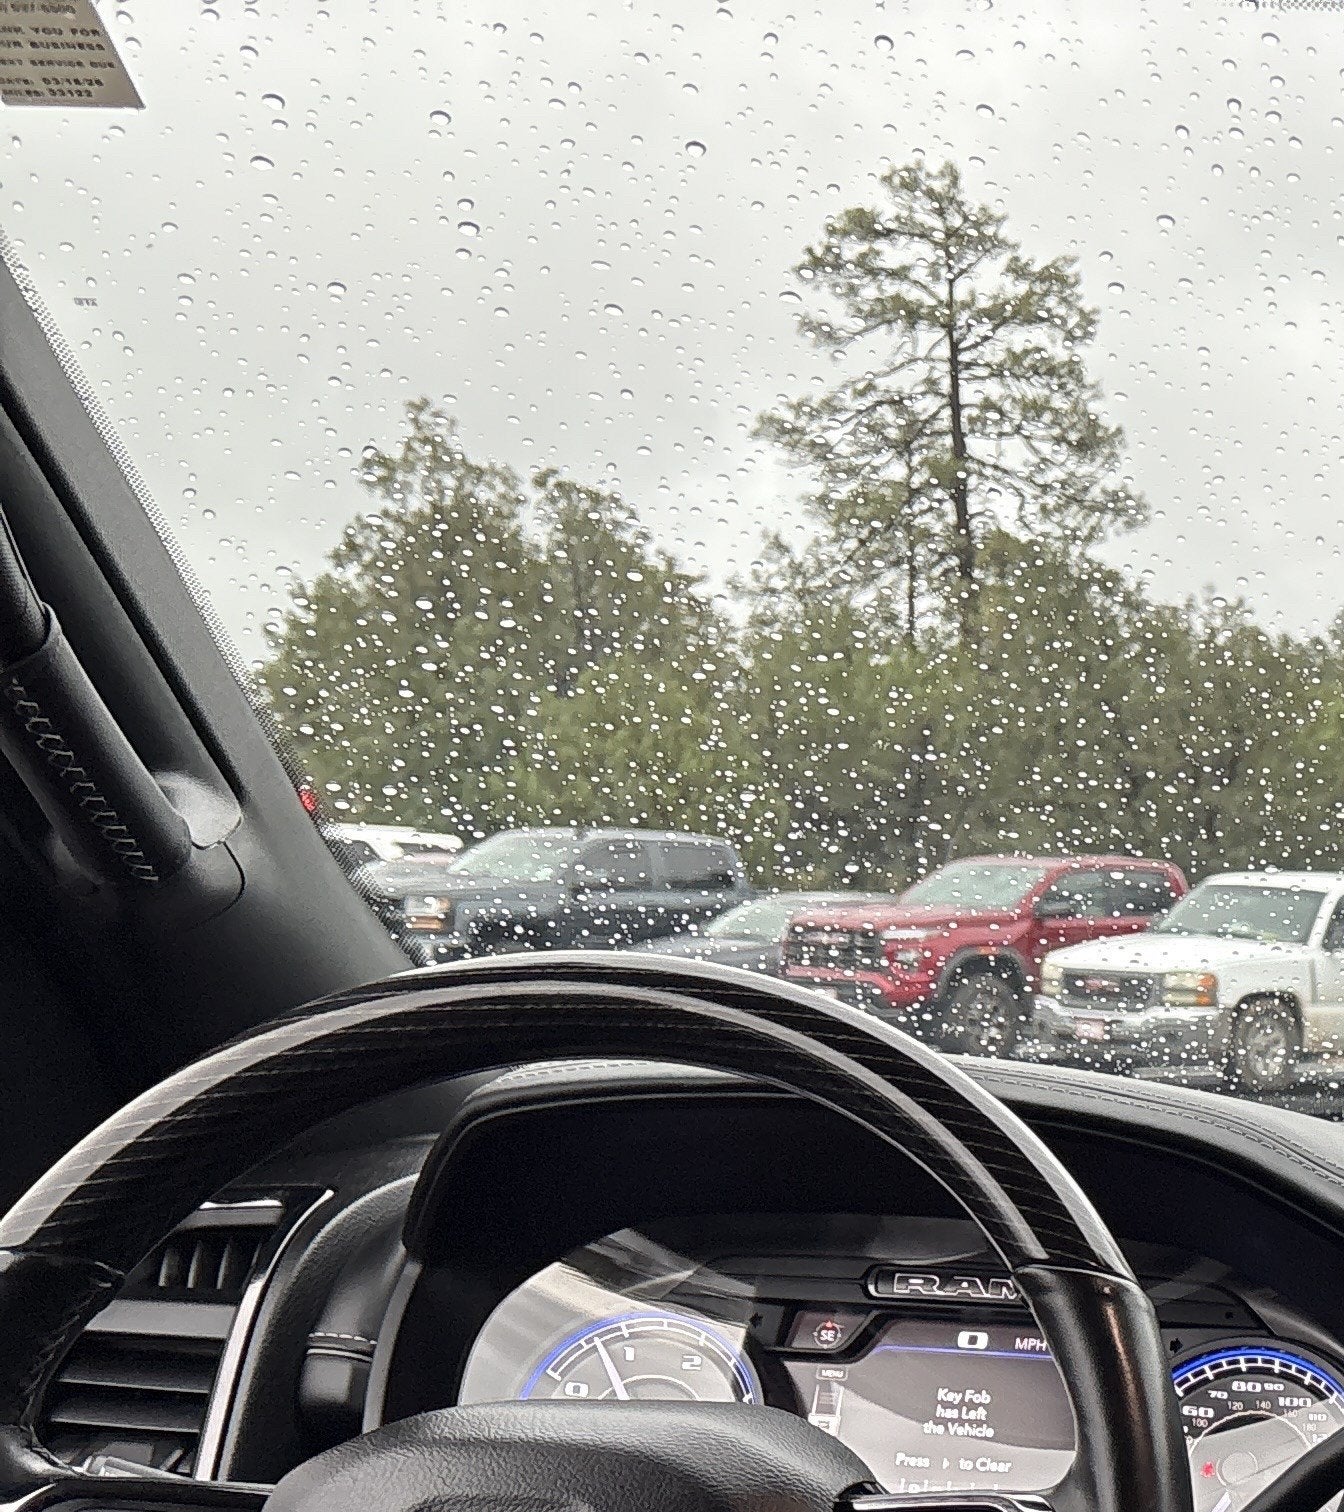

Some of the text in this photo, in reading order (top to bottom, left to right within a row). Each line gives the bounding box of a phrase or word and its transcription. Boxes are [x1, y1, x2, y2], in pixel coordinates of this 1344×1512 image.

[820, 1330, 835, 1342] SE
[957, 1330, 1047, 1352] 0 MPH
[623, 1346, 635, 1361] 1
[681, 1355, 702, 1370] 2
[564, 1381, 589, 1398] 0
[1231, 1380, 1262, 1393] 80
[1264, 1382, 1285, 1391] 90
[937, 1387, 992, 1405] Key Fob
[1207, 1389, 1229, 1399] 70
[1227, 1401, 1244, 1410] 120
[1255, 1400, 1272, 1410] 140
[1277, 1396, 1312, 1408] 100
[936, 1404, 988, 1421] has Left
[1182, 1405, 1215, 1418] 60
[922, 1419, 995, 1438] the Vehicle
[895, 1452, 1012, 1473] Press to Clear
